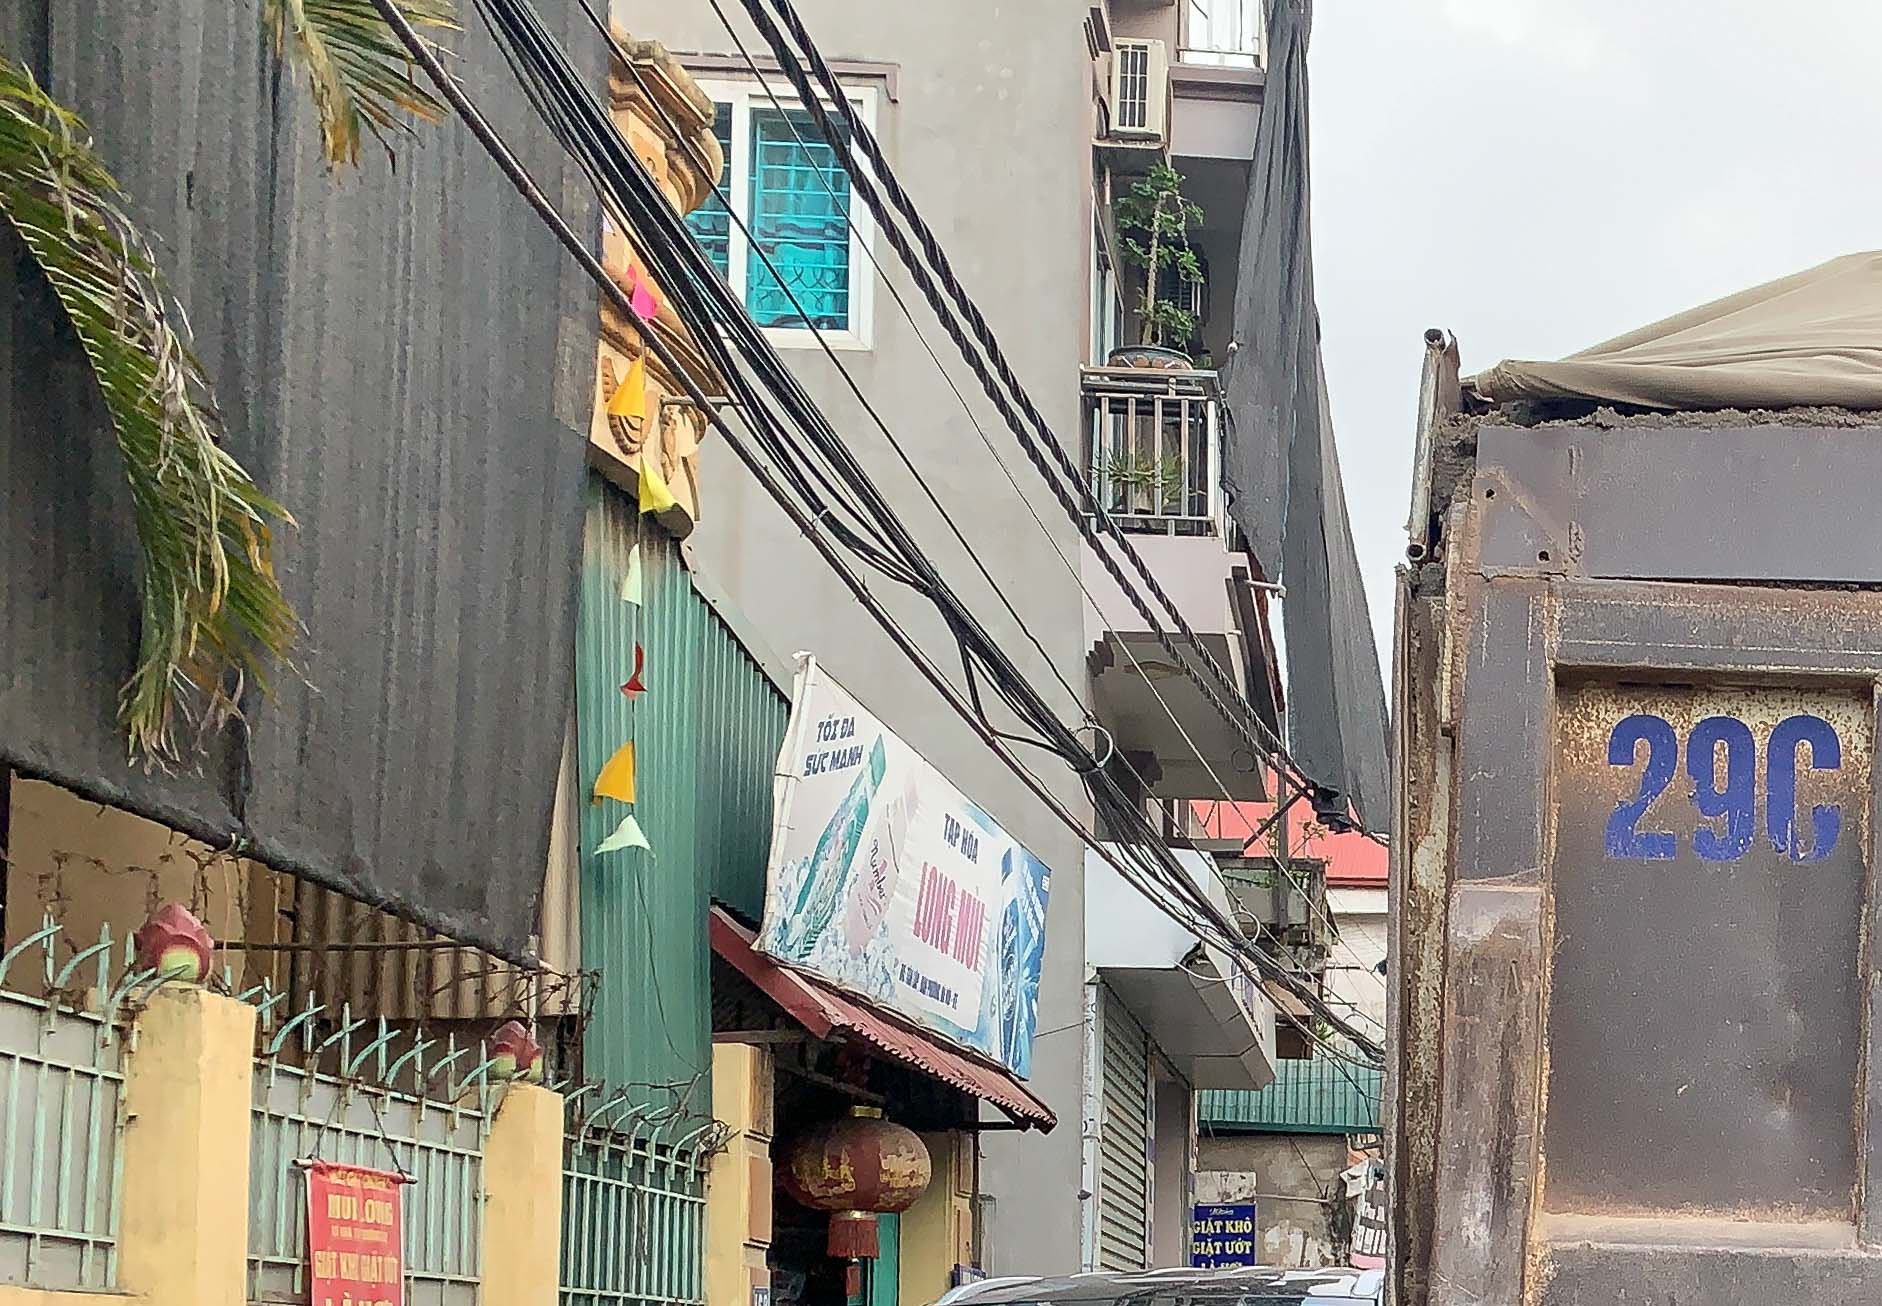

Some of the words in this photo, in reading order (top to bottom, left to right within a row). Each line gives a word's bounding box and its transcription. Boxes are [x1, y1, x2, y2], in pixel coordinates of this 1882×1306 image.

[1605, 714, 1842, 865] 29C
[1193, 1217, 1223, 1237] GIẶT
[1225, 1216, 1253, 1234] KHÔ
[1193, 1238, 1222, 1258] GIẶT
[1224, 1237, 1252, 1255] ƯỚT
